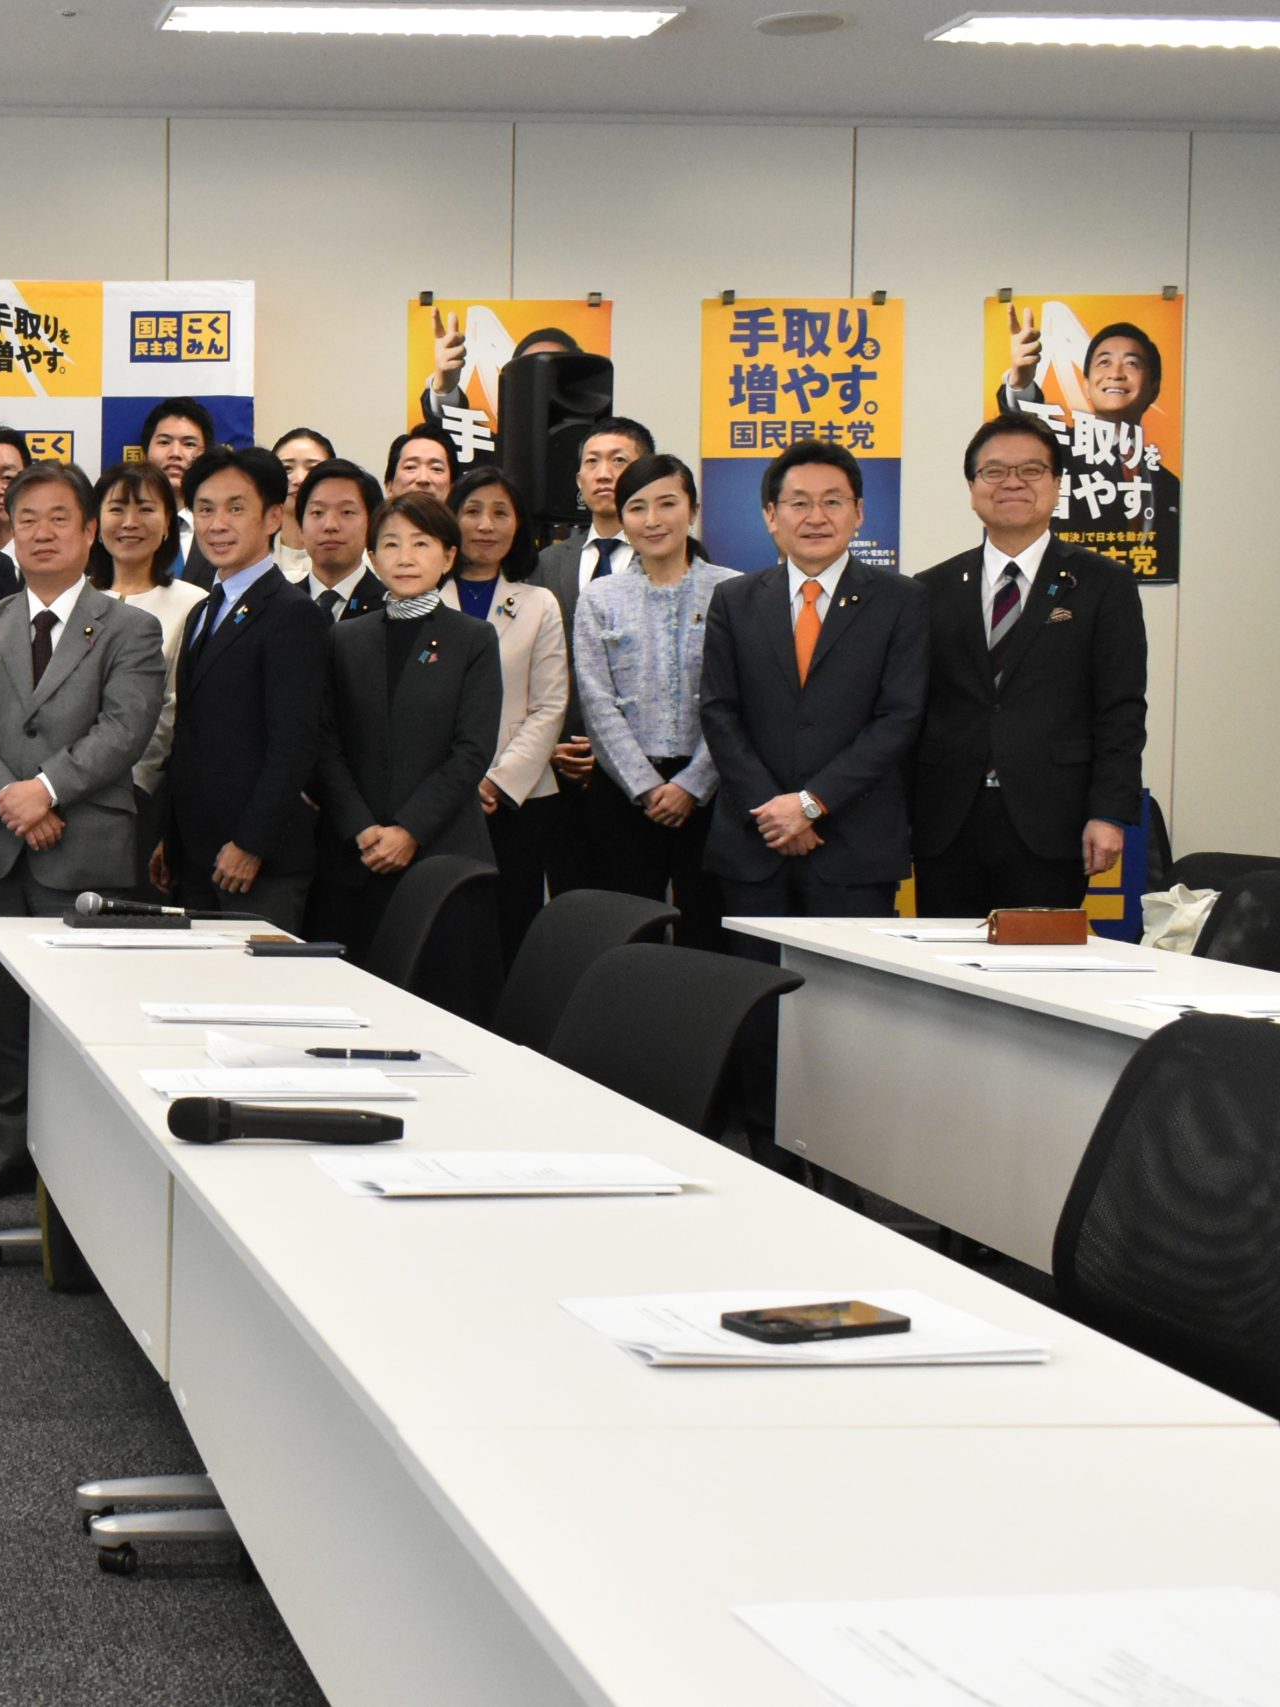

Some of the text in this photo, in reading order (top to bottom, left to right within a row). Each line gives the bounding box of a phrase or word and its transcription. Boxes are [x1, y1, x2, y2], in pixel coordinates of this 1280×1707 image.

[135, 317, 178, 338] 国民
[187, 317, 222, 335] こく
[729, 307, 880, 360] 手取りを
[135, 340, 178, 356] 民主党
[186, 338, 224, 356] みん
[729, 364, 878, 415] 増やす。
[730, 421, 874, 449] 国民民主党
[32, 437, 65, 454] こく
[1058, 532, 1157, 543] 解決」で日本を動かす
